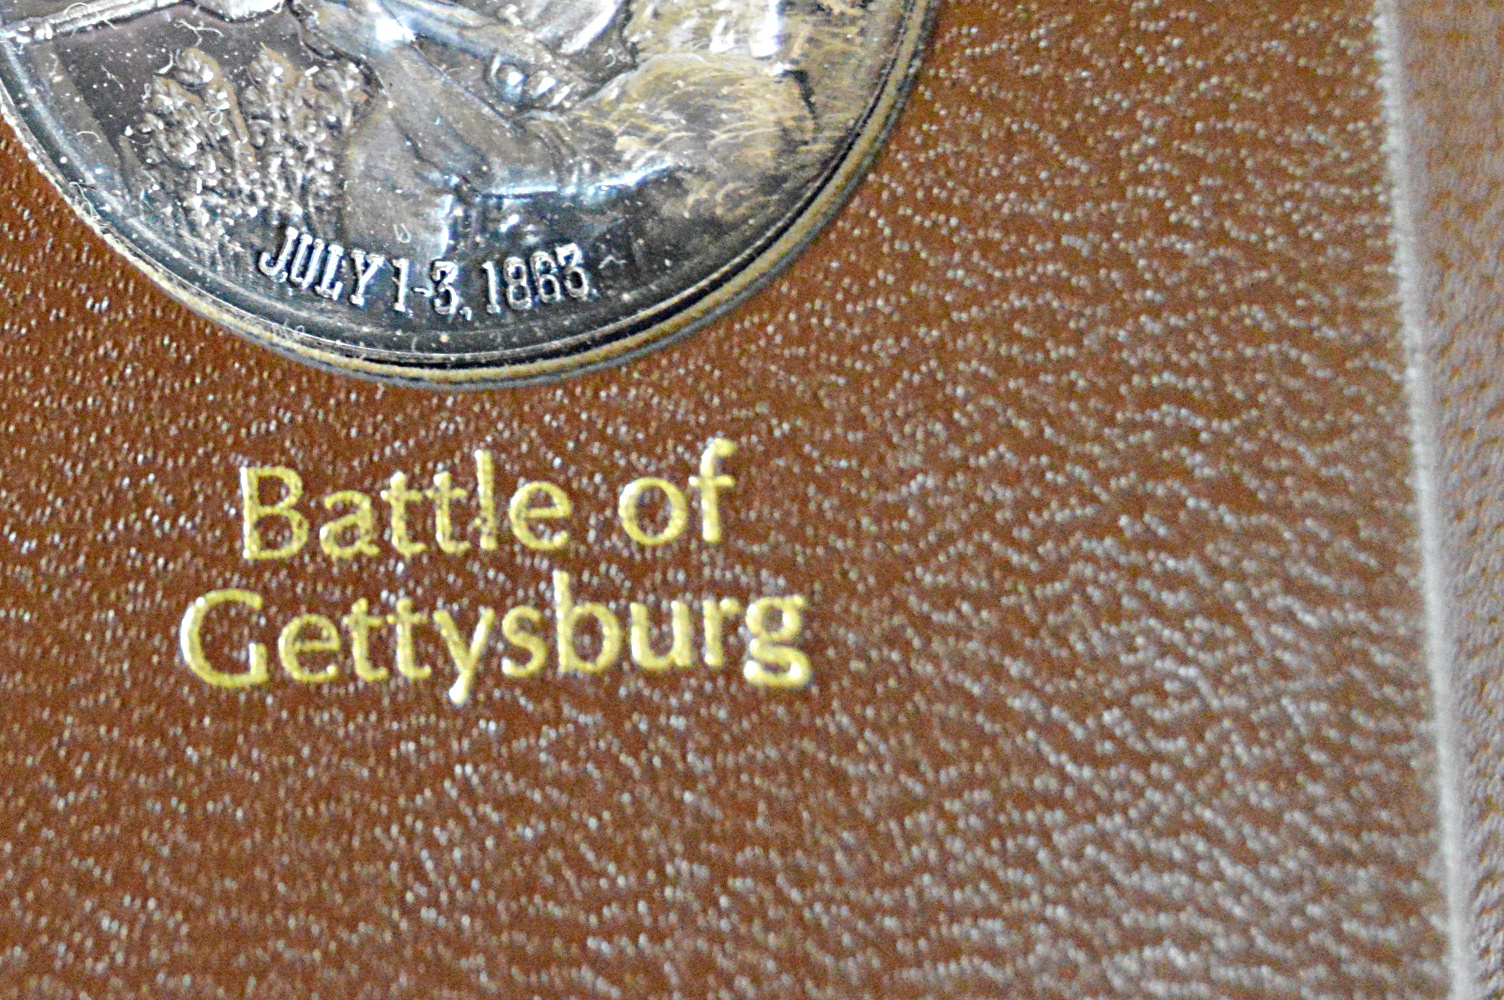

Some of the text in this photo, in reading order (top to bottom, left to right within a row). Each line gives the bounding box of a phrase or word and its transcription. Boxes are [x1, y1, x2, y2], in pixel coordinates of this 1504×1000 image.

[258, 225, 590, 321] JULY 1-3, 1863
[240, 437, 738, 561] Battle of
[179, 569, 814, 704] Gettysburg
